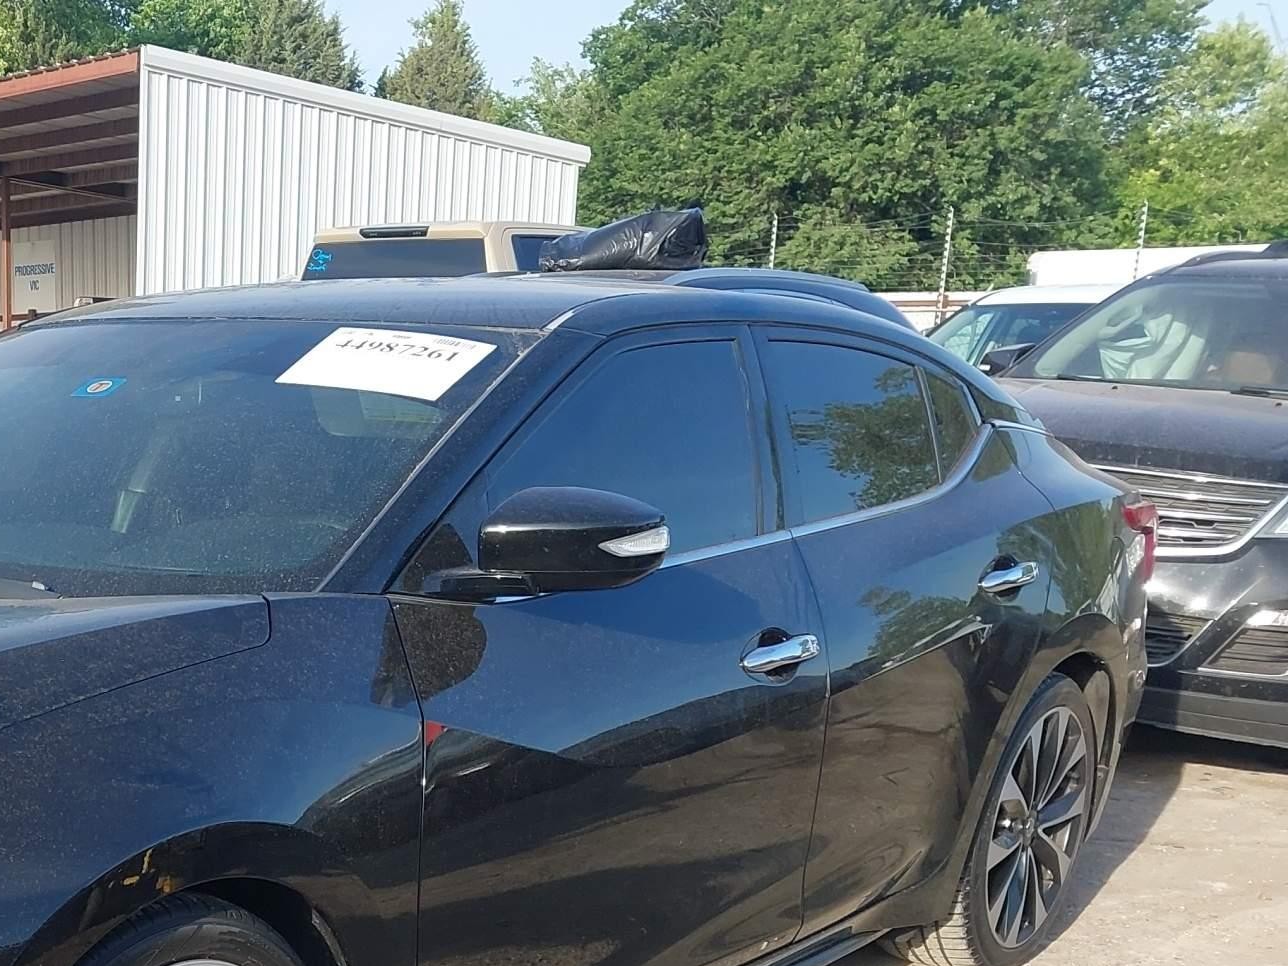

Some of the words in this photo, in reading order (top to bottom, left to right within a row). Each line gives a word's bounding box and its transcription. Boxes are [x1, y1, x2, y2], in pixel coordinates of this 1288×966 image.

[15, 263, 56, 276] PROGRESSIVE
[29, 279, 40, 291] VIC
[336, 339, 460, 362] 44987261
